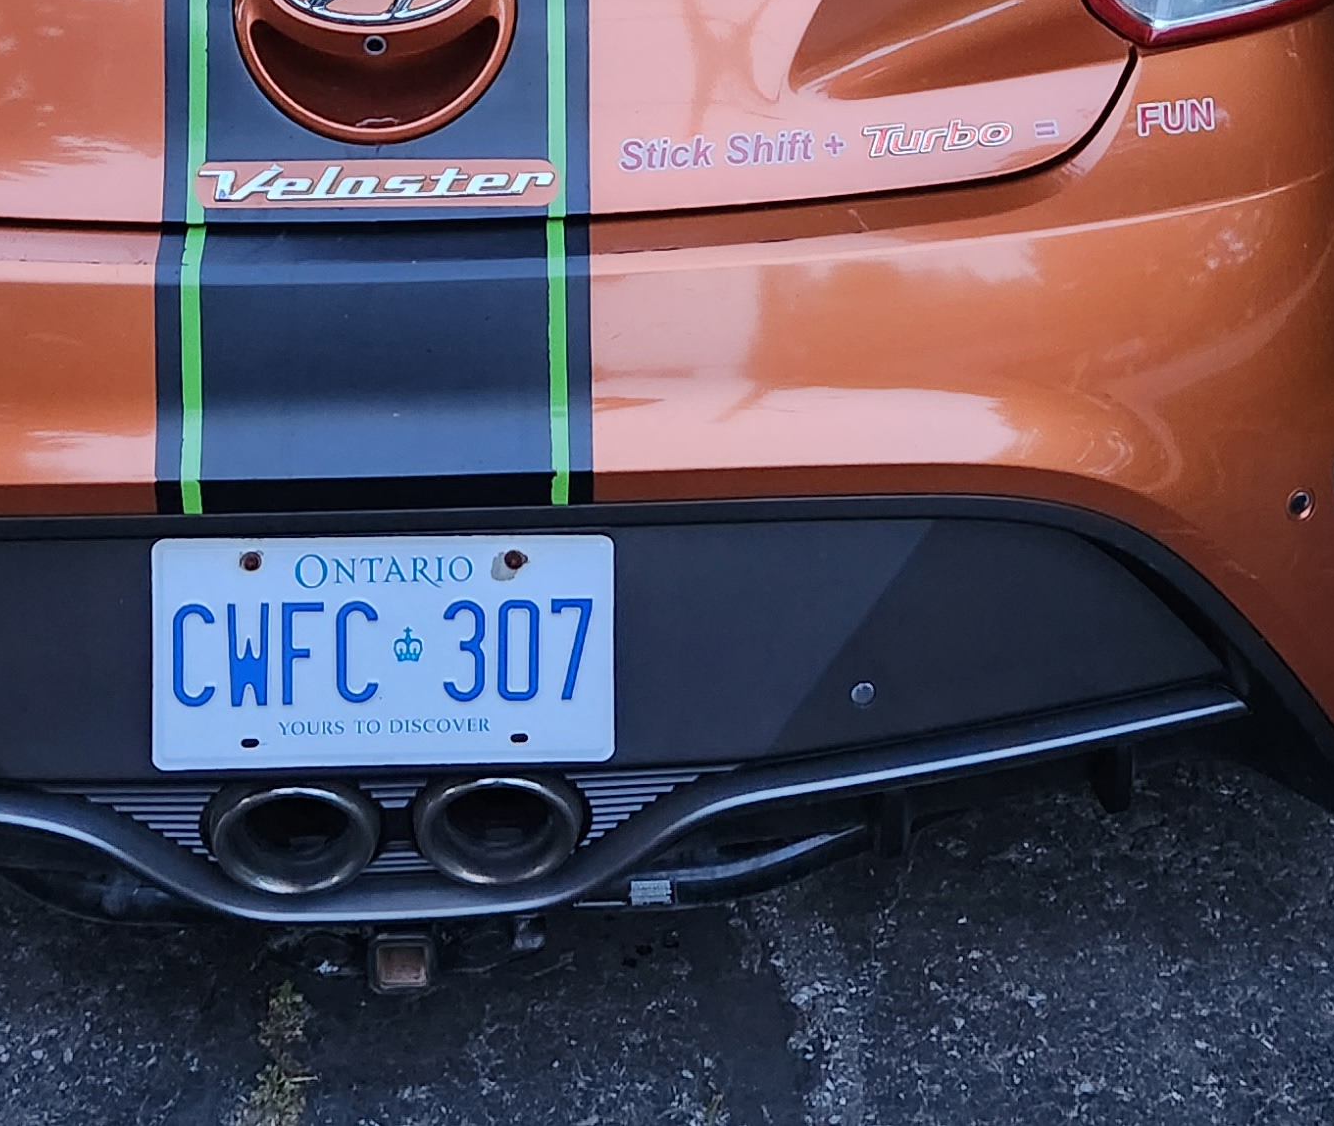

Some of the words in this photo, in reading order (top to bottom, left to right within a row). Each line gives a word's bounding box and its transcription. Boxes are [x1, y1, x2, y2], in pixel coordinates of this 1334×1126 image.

[620, 137, 714, 171] Stick
[726, 130, 813, 165] Shift
[862, 119, 1013, 157] Turbo
[1136, 99, 1216, 136] FUN
[198, 163, 556, 202] Veloster
[295, 554, 473, 588] ONTARIO
[172, 600, 379, 706] CWFC
[443, 598, 593, 702] 307
[278, 720, 345, 736] YOURS
[353, 719, 381, 735] TO
[388, 717, 491, 734] DISCOVER
